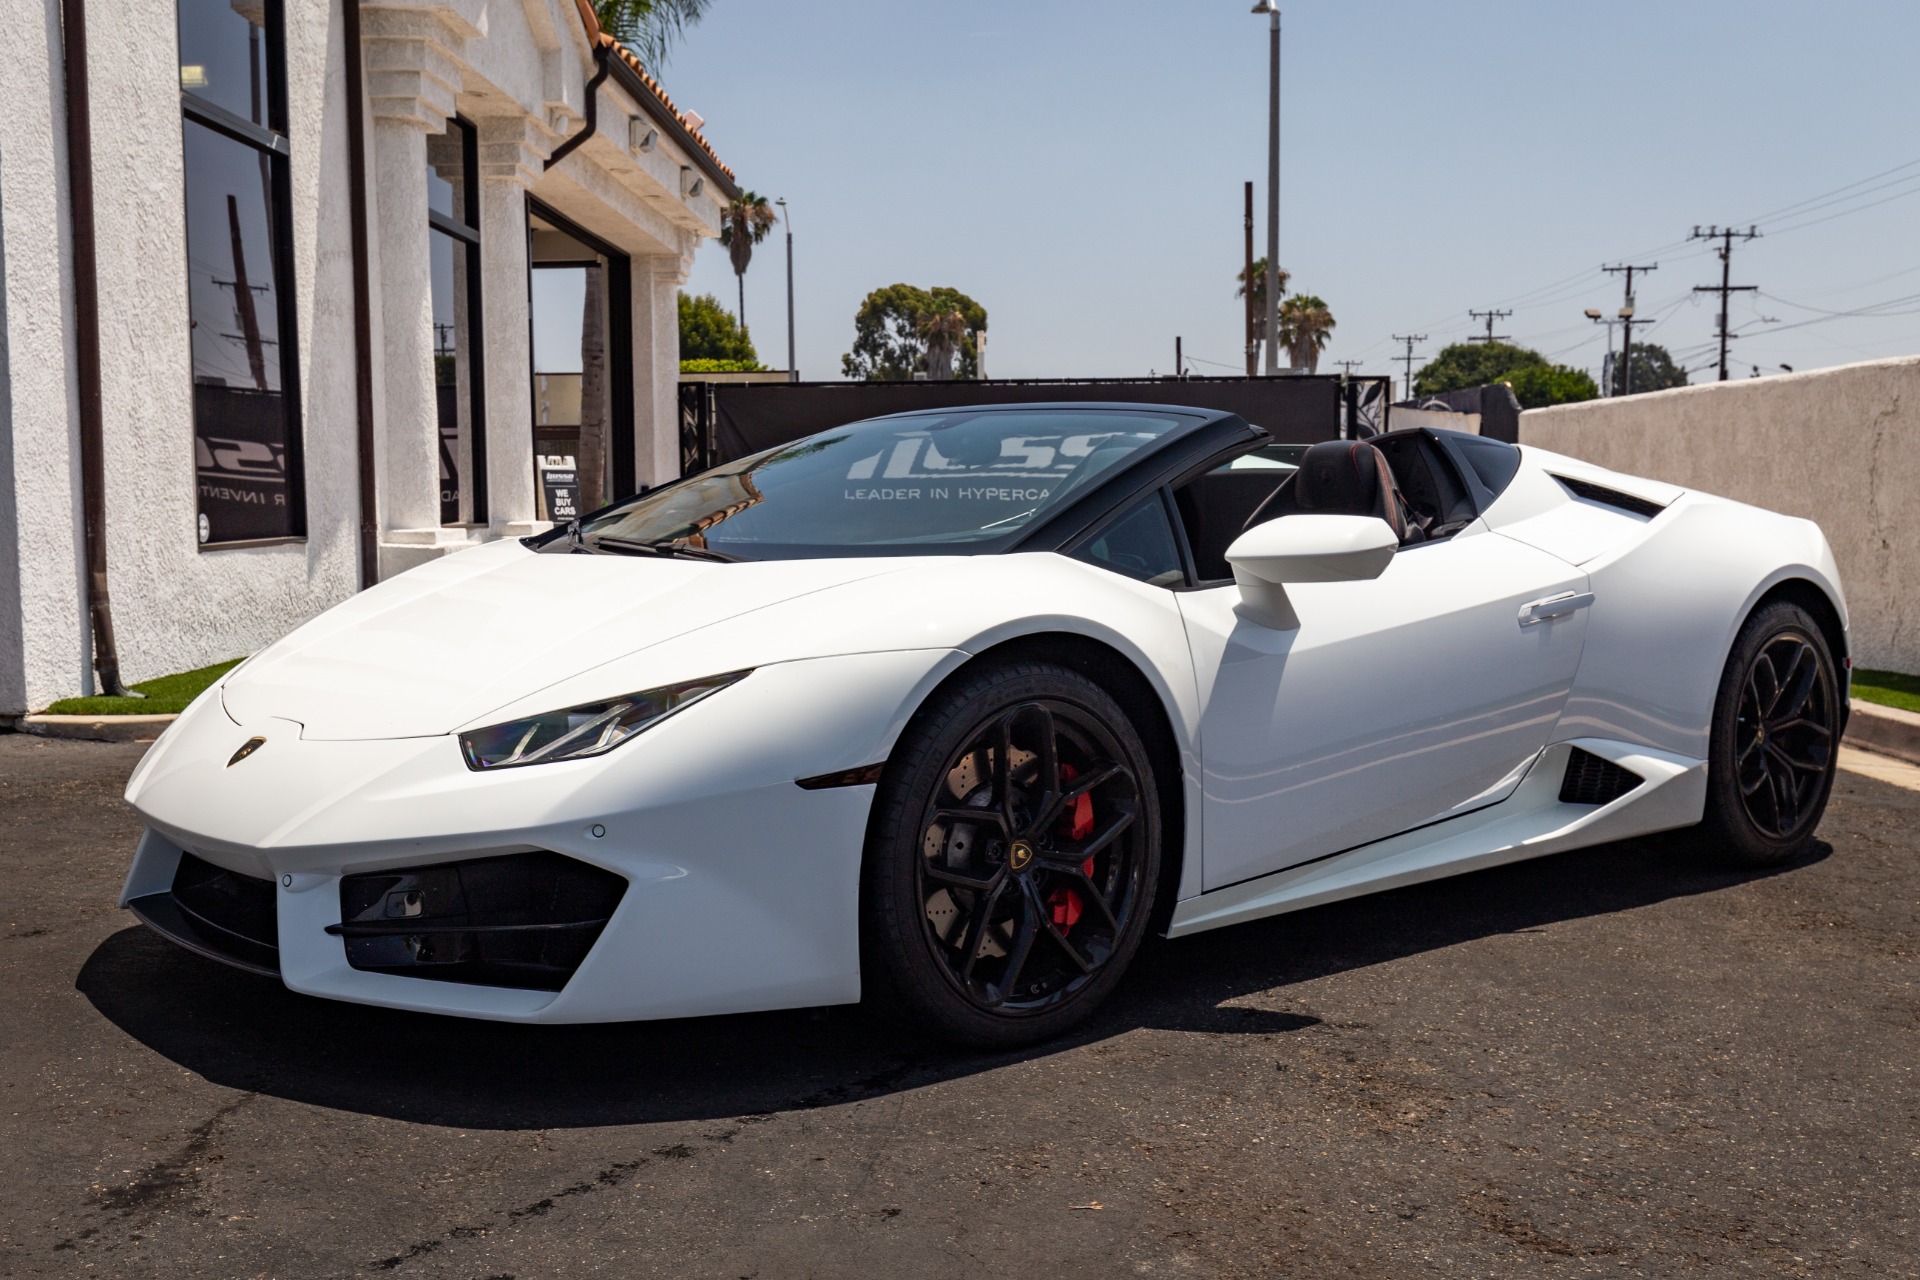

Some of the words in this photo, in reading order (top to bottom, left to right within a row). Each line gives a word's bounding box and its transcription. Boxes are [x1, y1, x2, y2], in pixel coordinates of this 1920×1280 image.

[555, 489, 569, 498] WE
[844, 488, 921, 500] LEADER
[930, 488, 948, 499] IN
[555, 498, 571, 507] BUY
[554, 506, 576, 516] CARS
